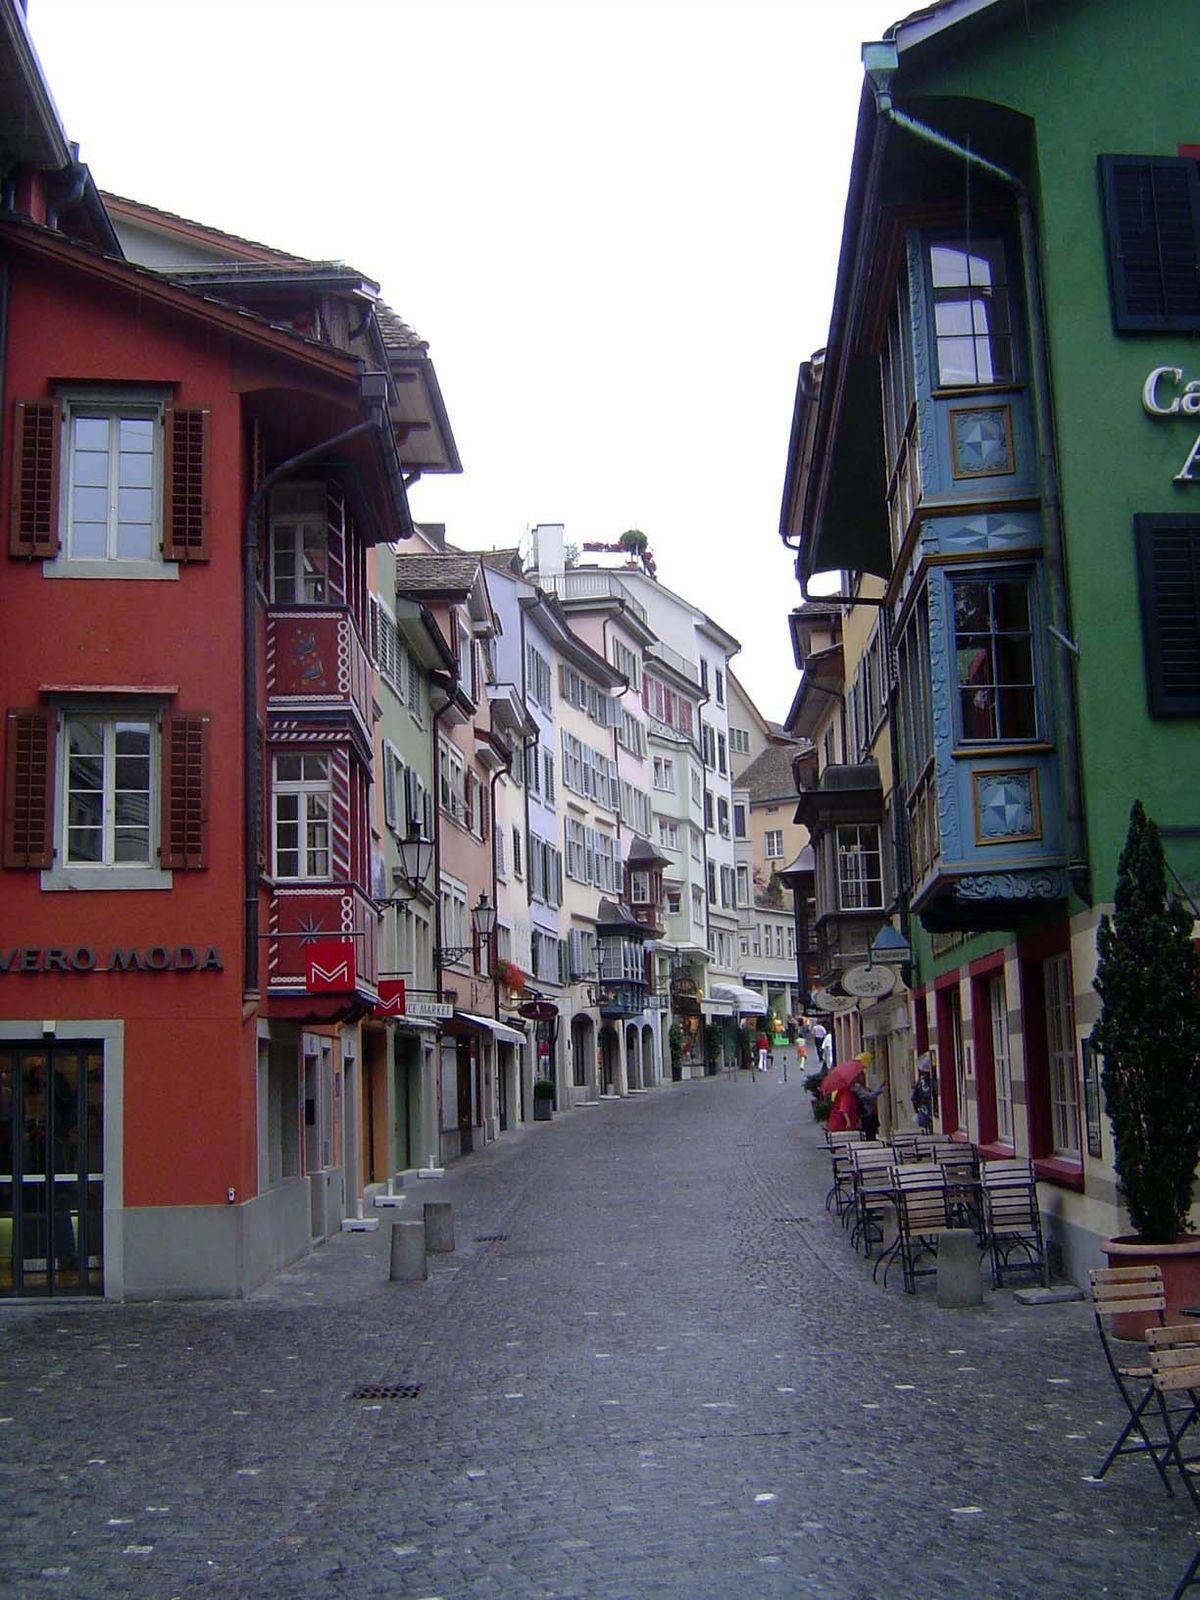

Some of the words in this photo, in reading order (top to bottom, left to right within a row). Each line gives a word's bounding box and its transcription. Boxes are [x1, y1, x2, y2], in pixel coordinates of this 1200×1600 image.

[0, 946, 95, 972] VERO
[108, 946, 223, 972] MODA
[419, 1003, 450, 1016] MARKET
